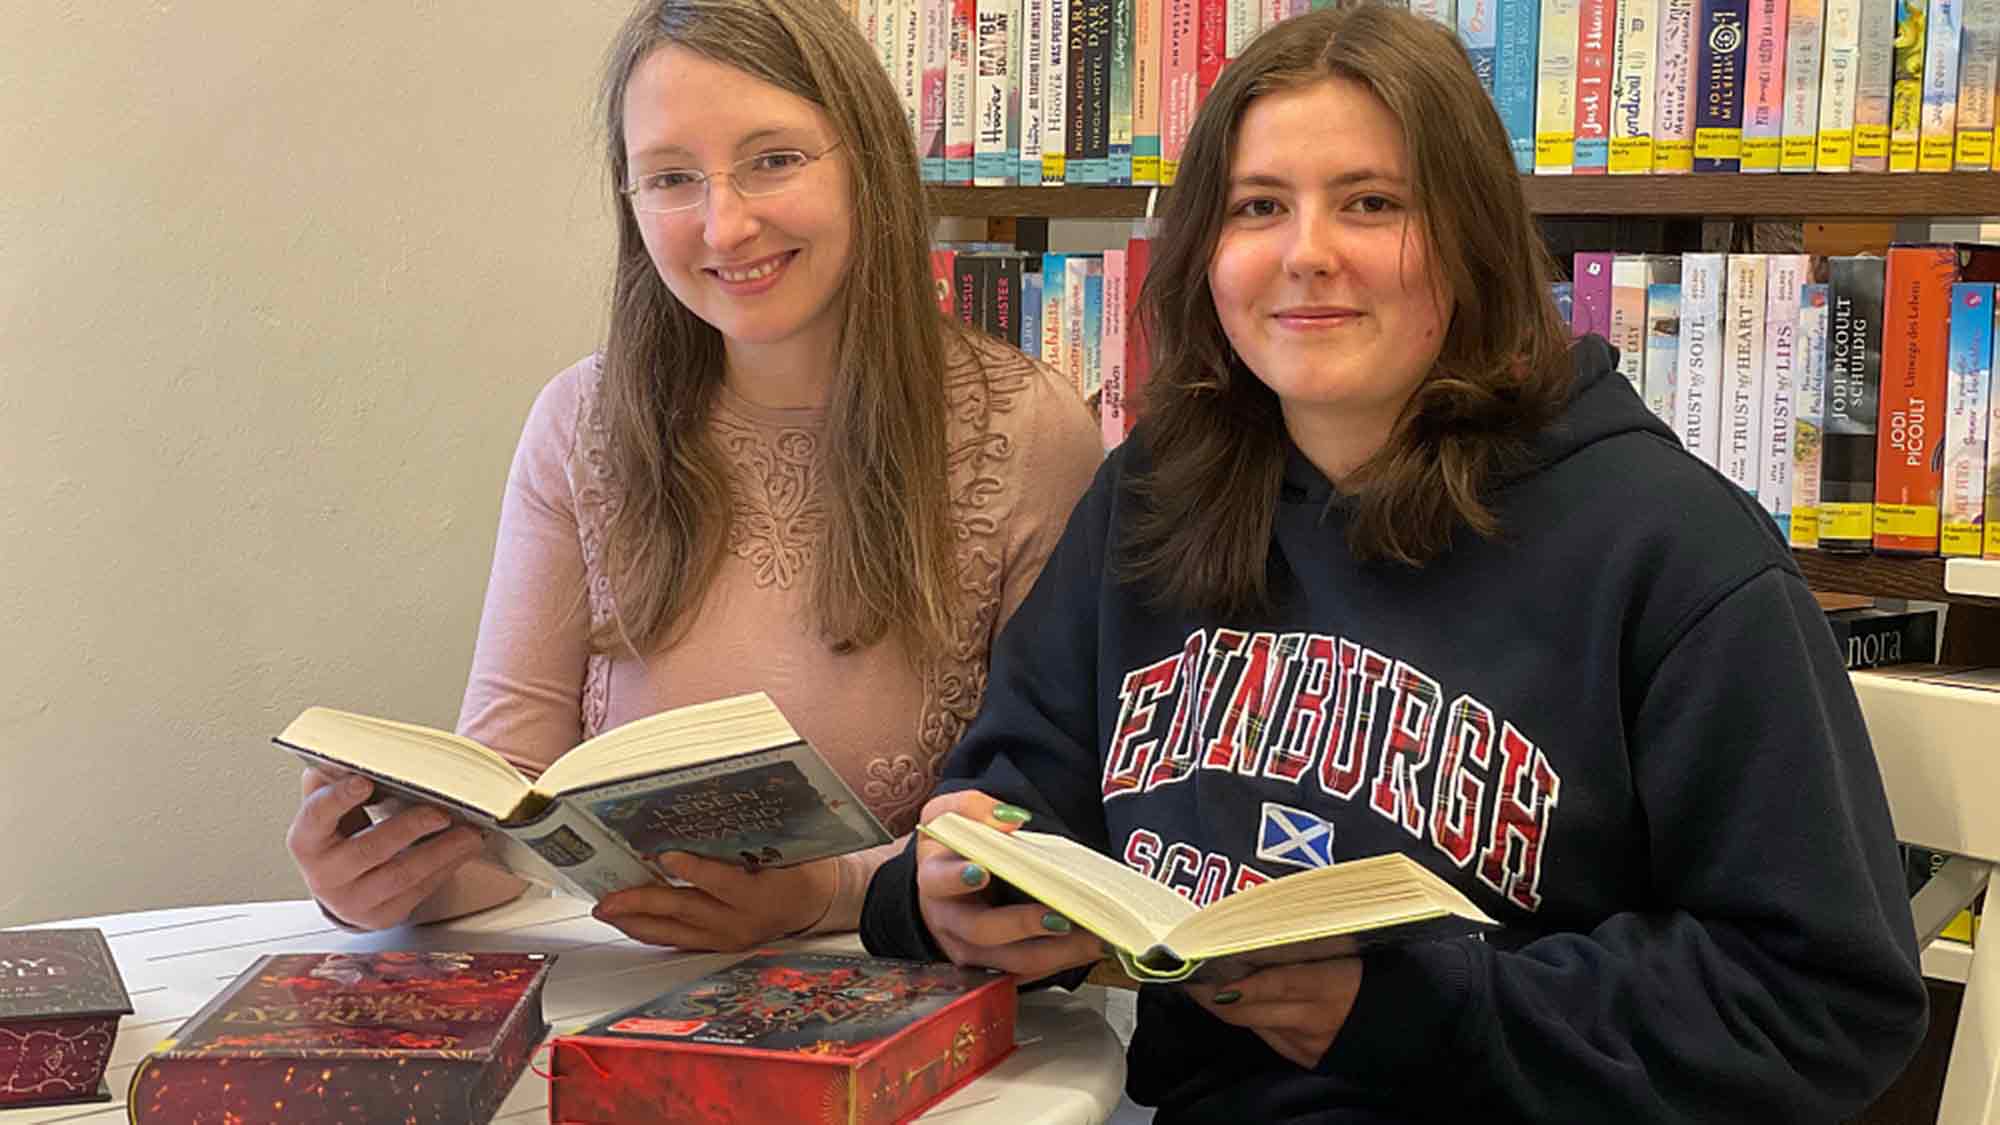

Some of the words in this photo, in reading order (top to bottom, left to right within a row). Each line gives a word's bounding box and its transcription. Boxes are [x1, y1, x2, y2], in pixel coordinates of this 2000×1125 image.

[979, 12, 997, 77] MAYBE
[981, 83, 1003, 144] Hoover
[997, 277, 1010, 330] MISTER
[1832, 295, 1852, 374] PICOULT
[1689, 315, 1705, 368] SOUL
[1736, 305, 1753, 369] HEART
[1775, 325, 1792, 369] LIPS
[1851, 318, 1867, 408] SCHULDIG
[1686, 389, 1702, 450] TRUST
[1732, 390, 1750, 455] TRUST
[1772, 393, 1788, 457] TRUST
[1832, 378, 1849, 420] JODI
[1890, 410, 1906, 452] JODI
[1906, 397, 1926, 466] PICOULT
[1102, 627, 1560, 913] EDINBURGH
